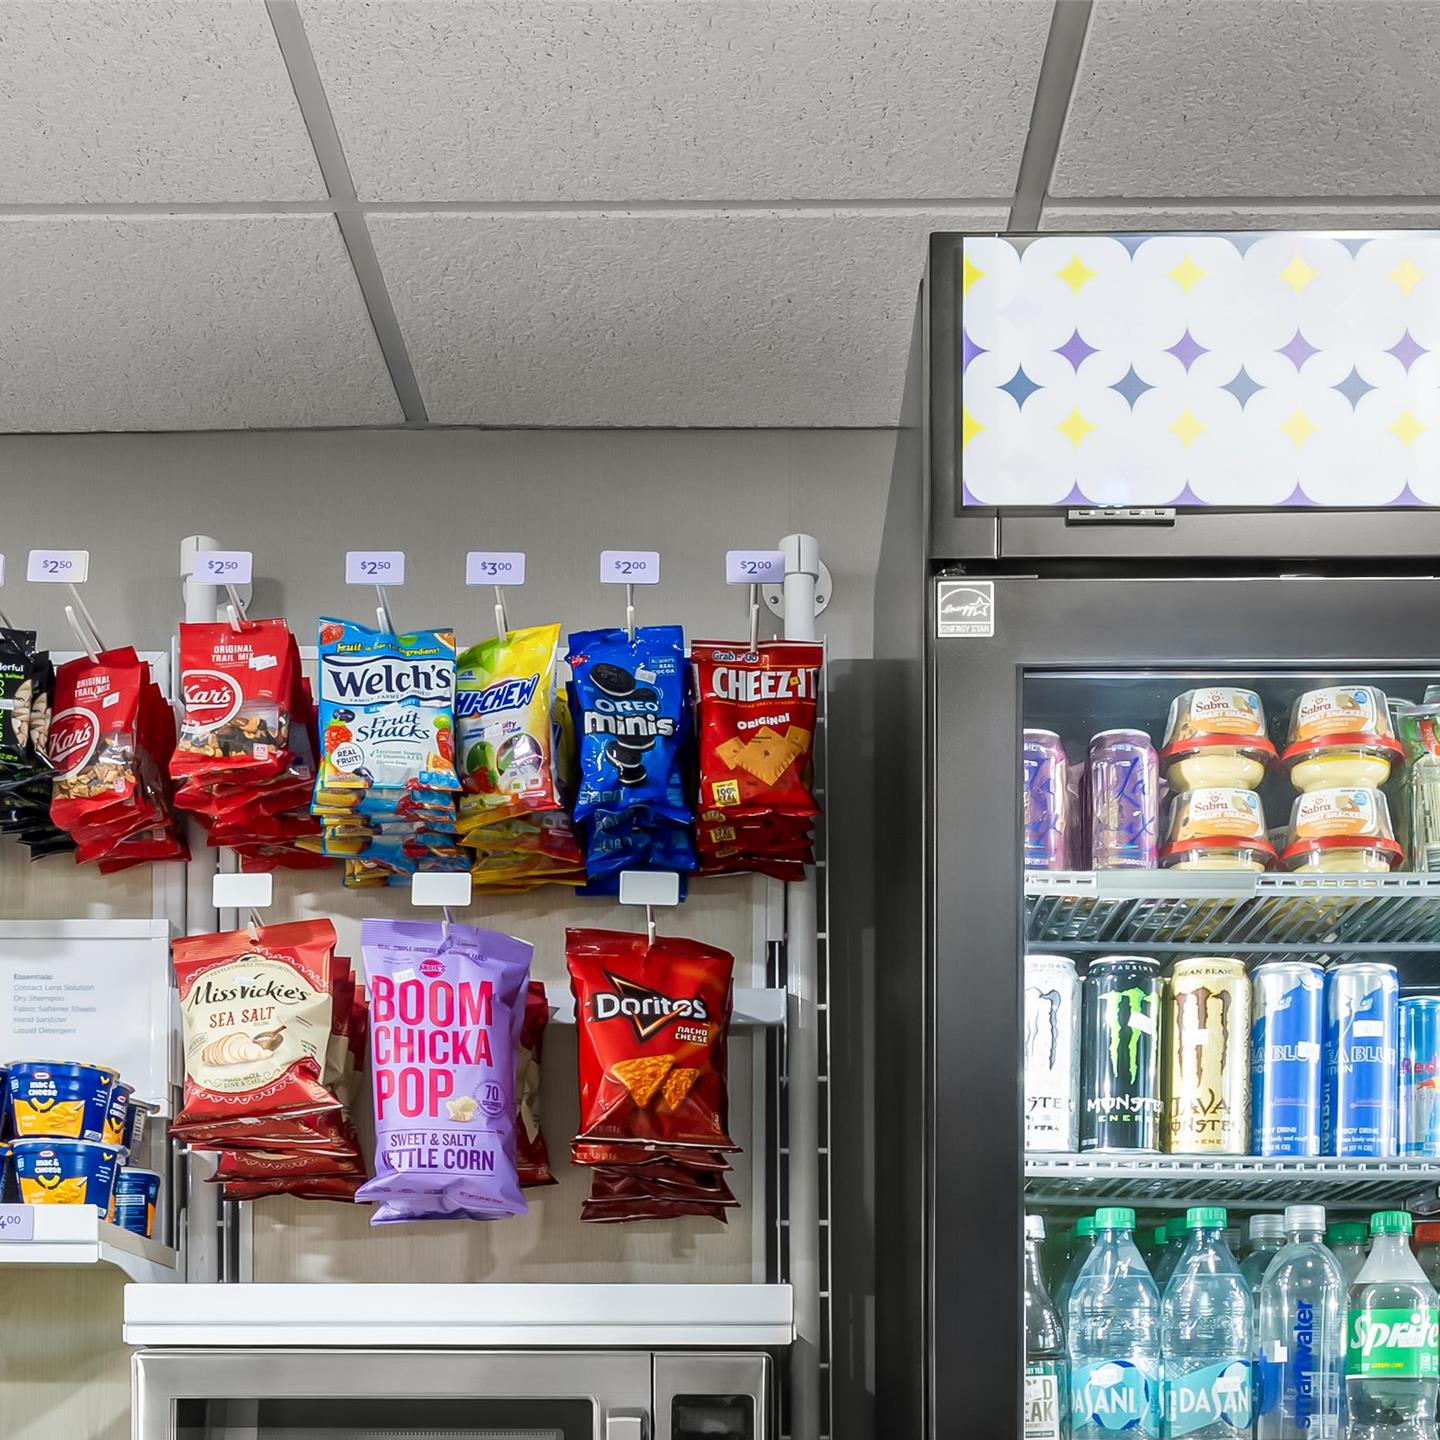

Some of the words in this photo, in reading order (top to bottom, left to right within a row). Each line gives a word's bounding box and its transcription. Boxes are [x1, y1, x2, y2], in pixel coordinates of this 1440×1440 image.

[212, 654, 235, 662] TRAIL
[213, 644, 253, 654] ORIGINAL
[328, 664, 450, 698] Welch's
[712, 668, 817, 700] CHEEZ-IT
[457, 673, 541, 718] HI-CHEW
[595, 699, 659, 712] OREO
[1196, 700, 1229, 713] Sabra
[372, 712, 420, 728] Fruit
[584, 711, 674, 736] minis
[738, 713, 791, 730] ORIGINAL
[356, 723, 430, 742] Snacks
[336, 750, 357, 758] REAL
[187, 983, 238, 1012] Miss
[371, 976, 493, 1028] BOOM
[596, 993, 708, 1019] Doritos
[209, 1012, 235, 1029] SEA
[240, 1006, 275, 1025] SALT
[675, 1033, 708, 1043] CHEESE
[677, 1026, 708, 1036] NACHO
[375, 1026, 494, 1068] CHICKA
[377, 1068, 454, 1121] POP
[485, 1085, 499, 1100] 70
[391, 1133, 427, 1146] SWEET
[430, 1133, 439, 1145] &
[443, 1134, 476, 1146] SALTY
[444, 1149, 494, 1171] CORN
